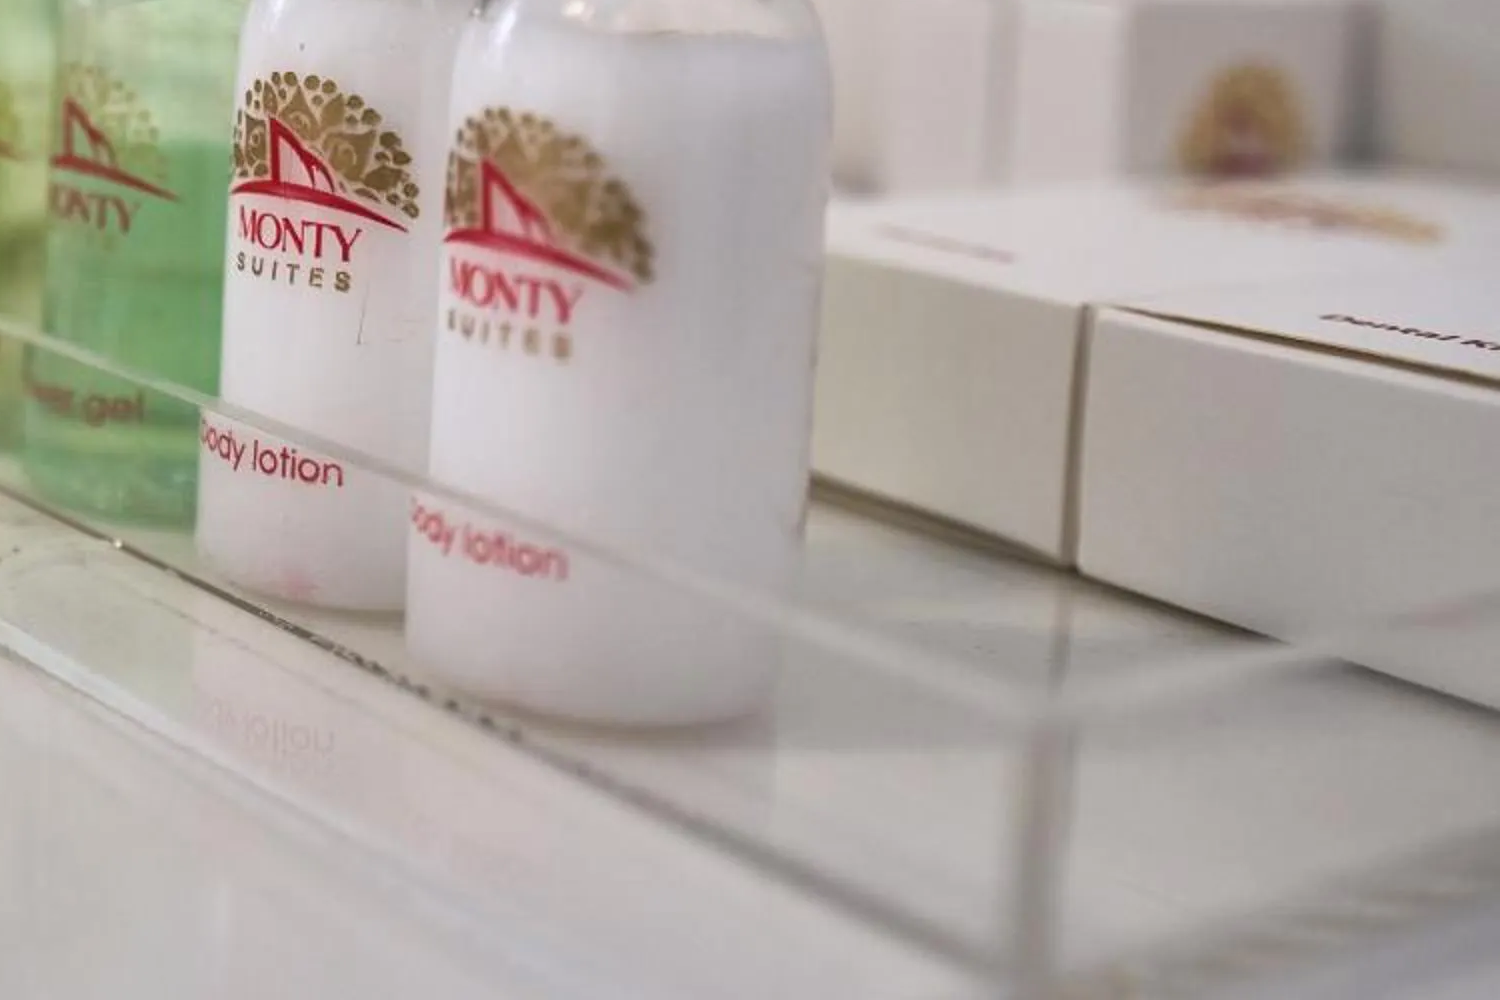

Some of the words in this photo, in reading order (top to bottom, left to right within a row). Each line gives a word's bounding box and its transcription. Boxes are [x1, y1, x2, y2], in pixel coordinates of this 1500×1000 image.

[240, 203, 362, 262] MONTY
[237, 251, 351, 293] SUITES
[252, 438, 344, 487] lotion
[411, 496, 455, 557] ody
[462, 522, 569, 582] lotion
